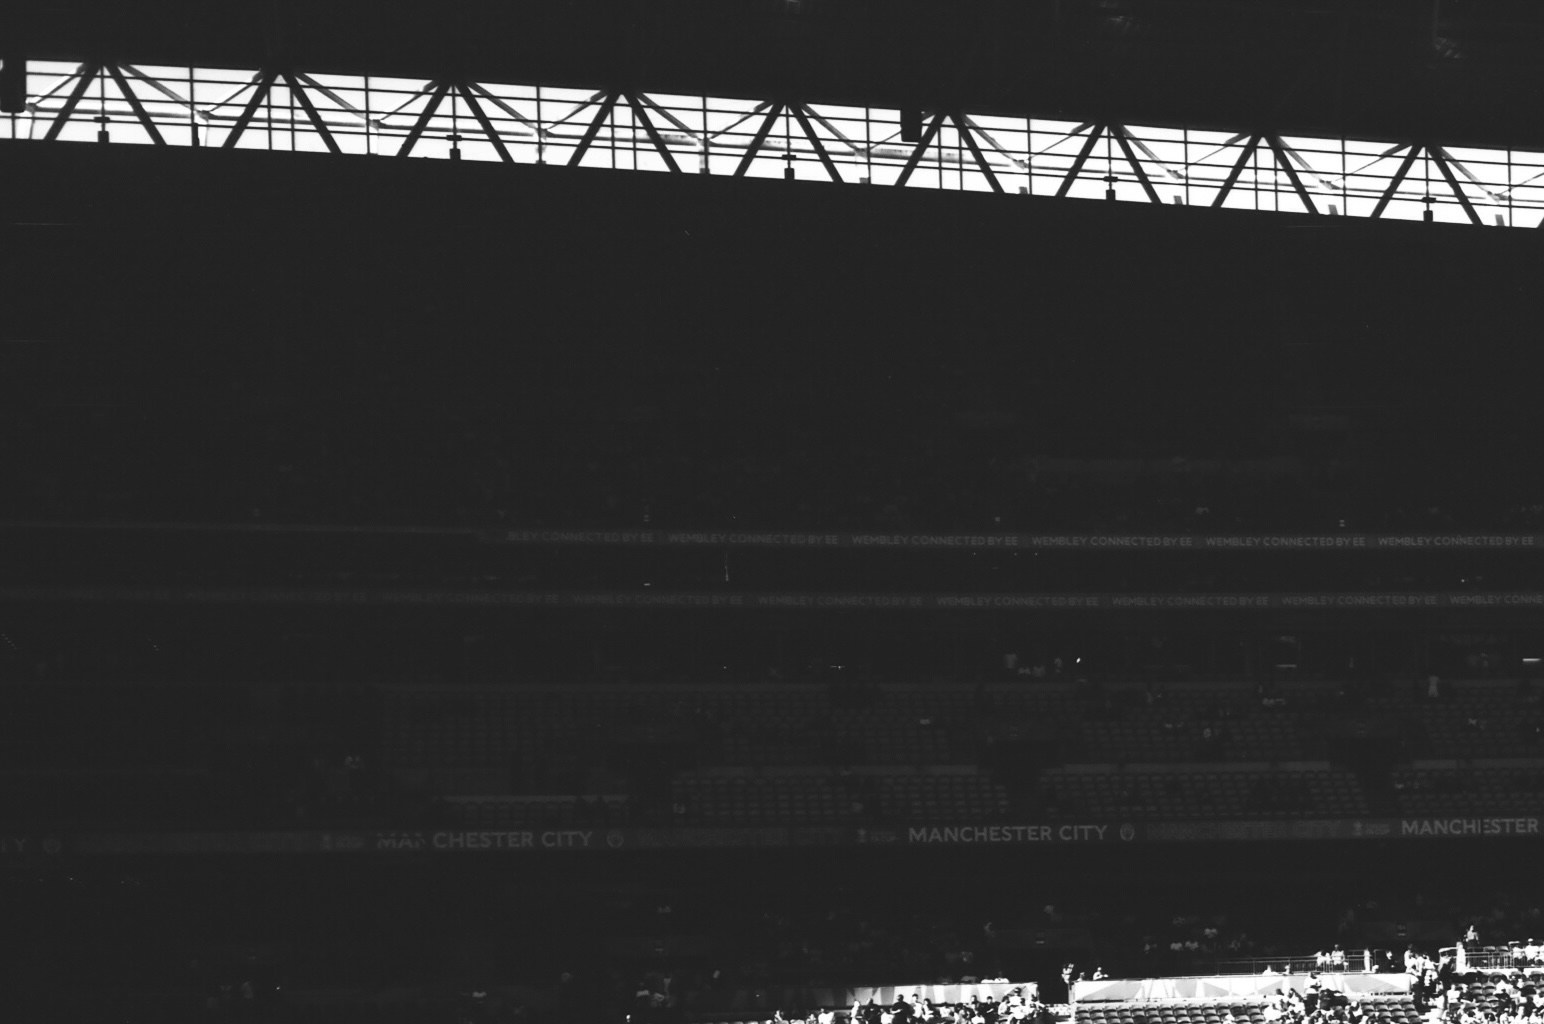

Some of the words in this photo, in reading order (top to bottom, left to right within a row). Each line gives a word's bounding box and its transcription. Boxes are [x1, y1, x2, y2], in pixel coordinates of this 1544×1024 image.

[852, 535, 908, 545] WEMBLEY
[912, 535, 985, 546] CONNECTED
[987, 535, 1002, 546] BY
[1004, 536, 1018, 546] EE
[1032, 536, 1088, 546] WEMBLEY
[1090, 536, 1161, 546] CONNECTED
[1163, 536, 1178, 546] BY
[1180, 536, 1193, 546] EE
[1206, 537, 1261, 546] WEMBLEY
[1263, 537, 1334, 546] CONNECTED
[1335, 537, 1351, 546] BY
[1353, 537, 1366, 546] EE
[1378, 537, 1431, 546] WEMBLEY
[1433, 537, 1503, 546] CONNECTED
[1505, 537, 1520, 546] BY
[1522, 537, 1534, 546] EE
[1281, 596, 1334, 606] WEMBLEY
[1336, 595, 1407, 606] CONNECTED
[1408, 595, 1422, 605] BY
[1424, 595, 1437, 605] EE
[1449, 595, 1501, 605] WEMBLEY
[1401, 818, 1539, 835] MANCHESTER
[541, 831, 593, 848] CITY
[908, 826, 1053, 843] MANCHESTER
[1059, 825, 1108, 841] CITY
